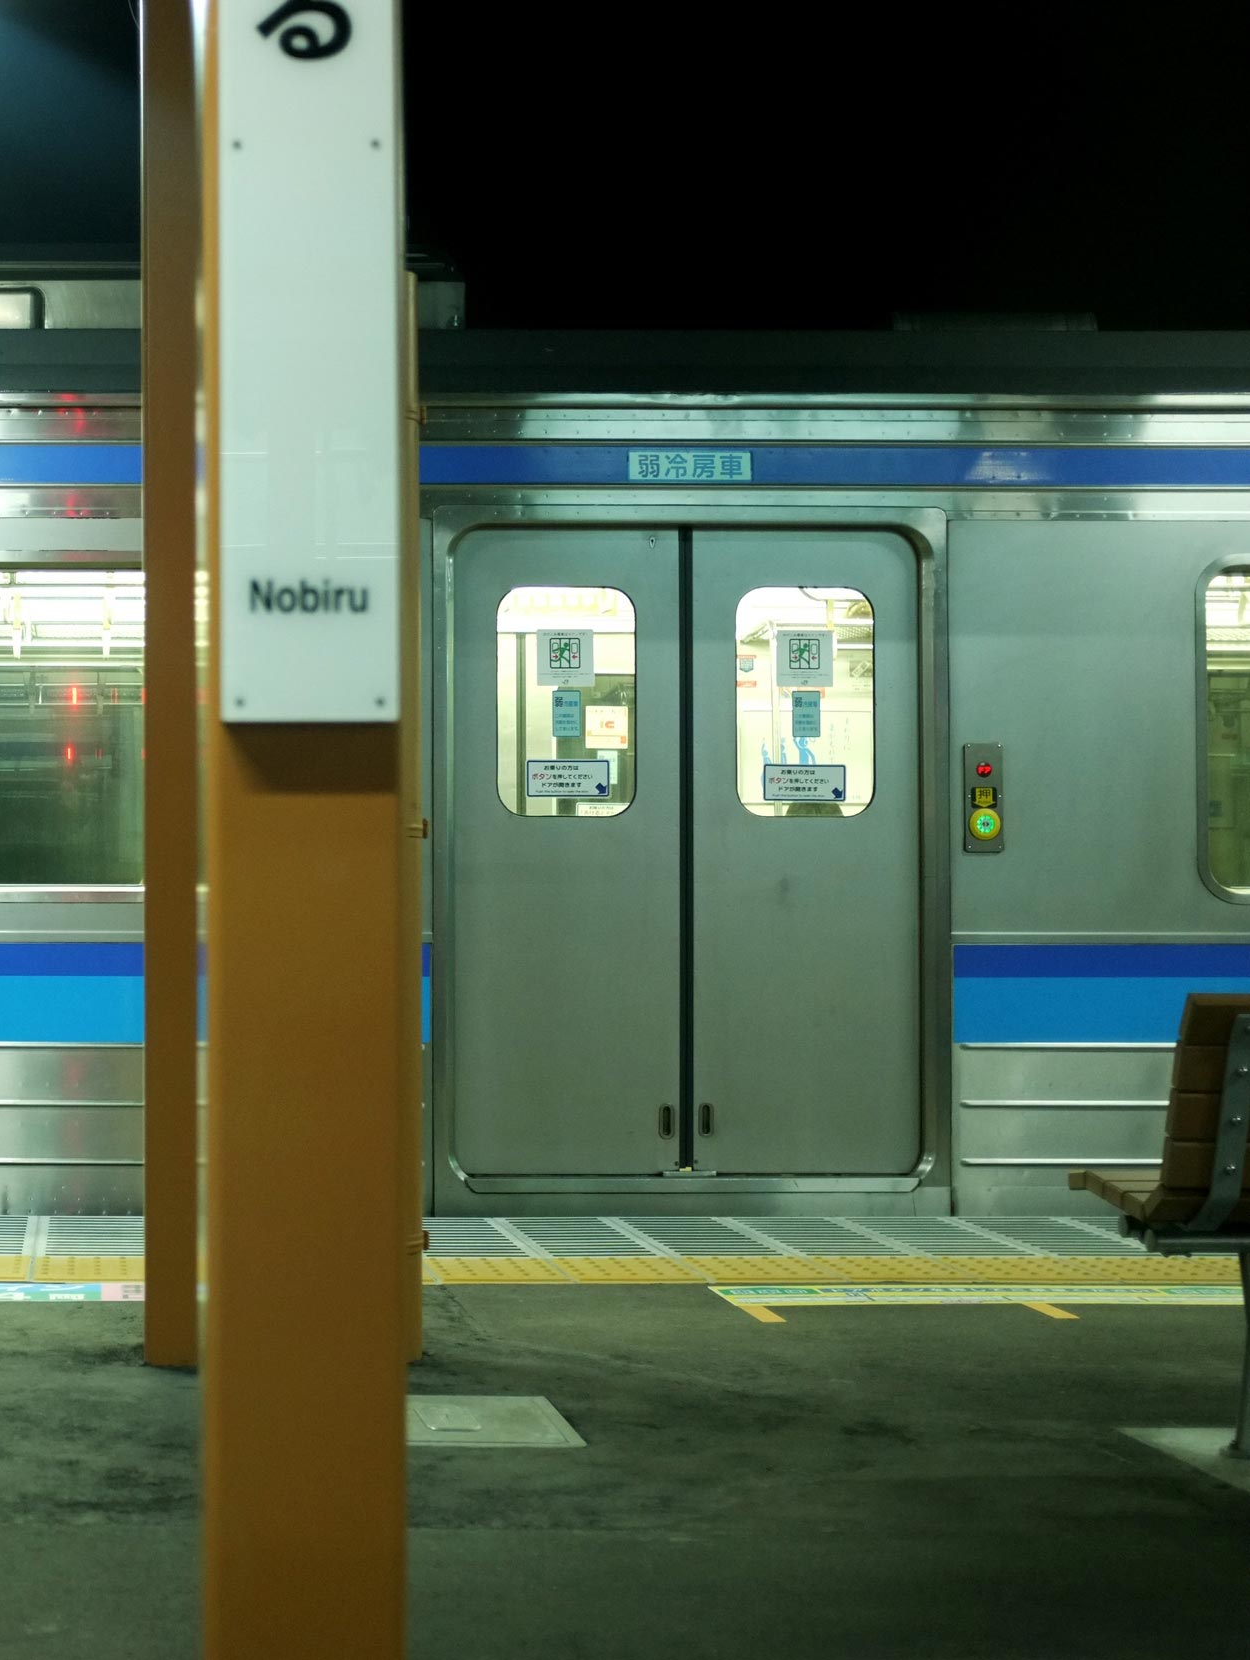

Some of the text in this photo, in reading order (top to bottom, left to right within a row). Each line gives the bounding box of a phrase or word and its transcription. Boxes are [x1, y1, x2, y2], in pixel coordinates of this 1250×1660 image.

[638, 454, 743, 479] 弱冷房車
[250, 578, 369, 613] Nobiru
[978, 789, 991, 800] 押
